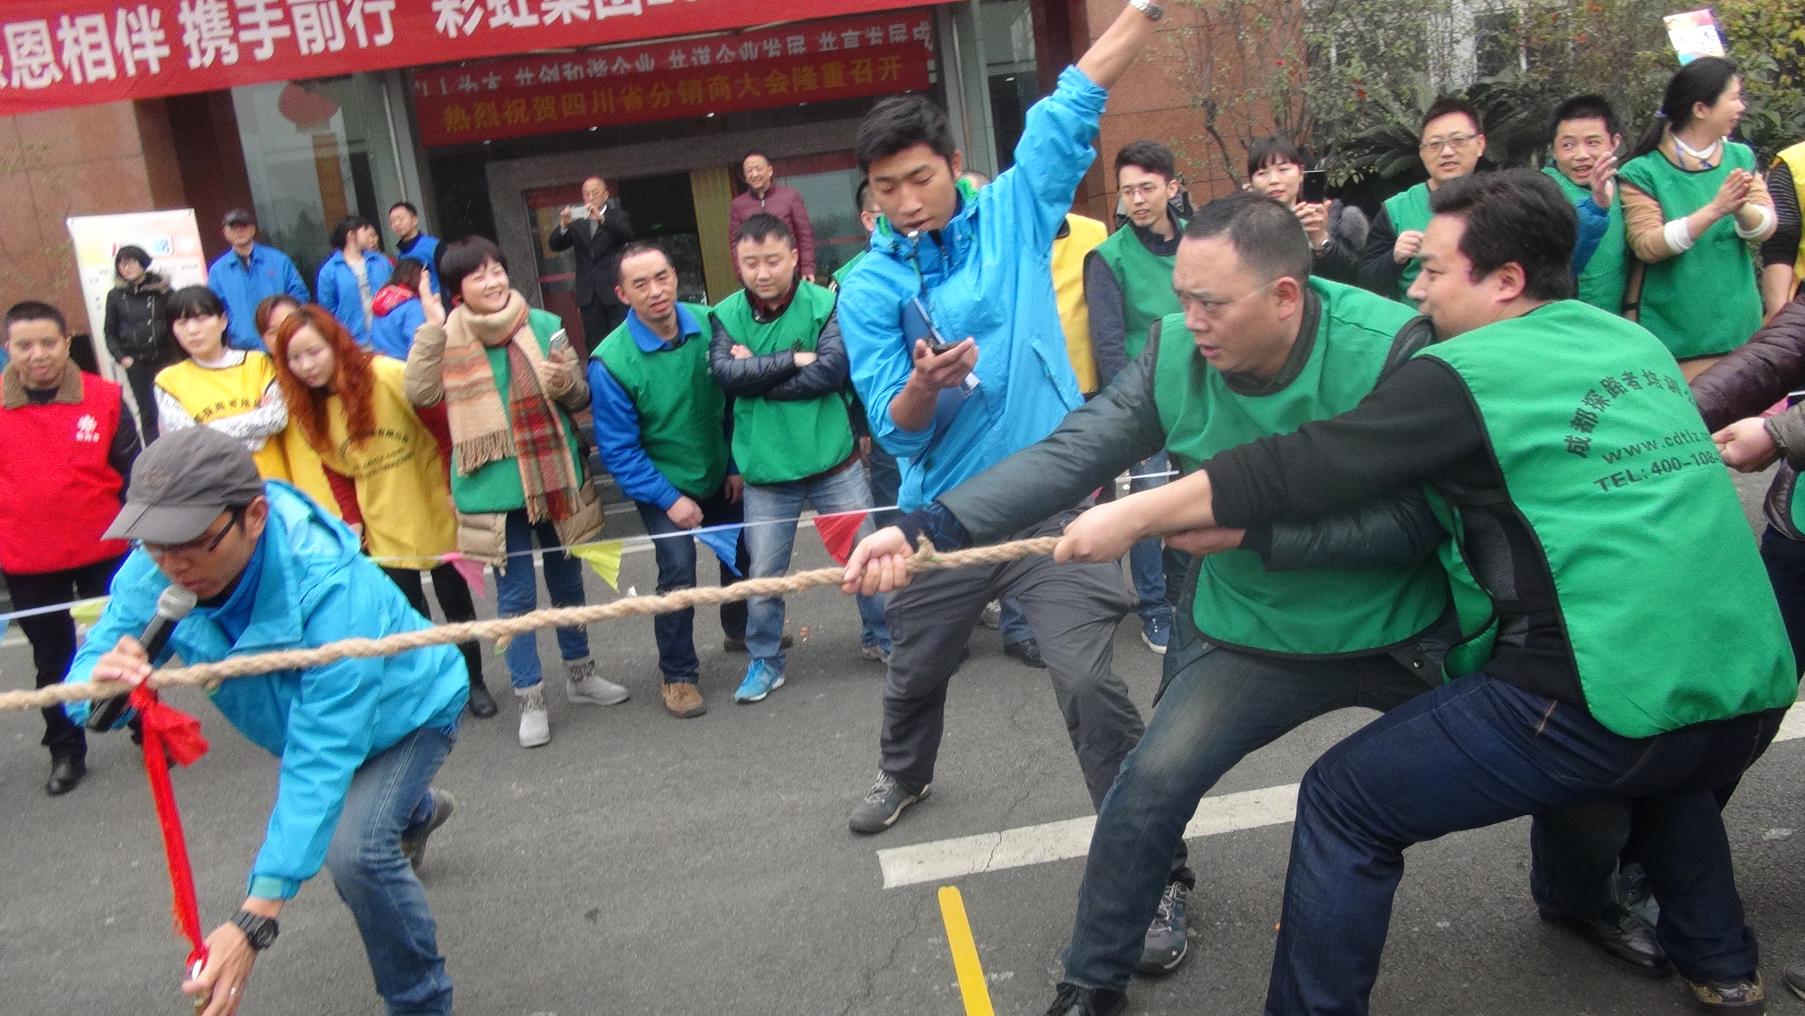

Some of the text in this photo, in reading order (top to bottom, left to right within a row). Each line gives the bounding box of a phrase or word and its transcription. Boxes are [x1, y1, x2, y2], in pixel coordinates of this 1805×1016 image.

[0, 8, 172, 91] 恩相伴
[178, 0, 396, 71] 携手前行
[443, 55, 903, 134] 热烈祝贺四川省分销商大会隆重召开
[1564, 367, 1697, 459] 成都探路者培训
